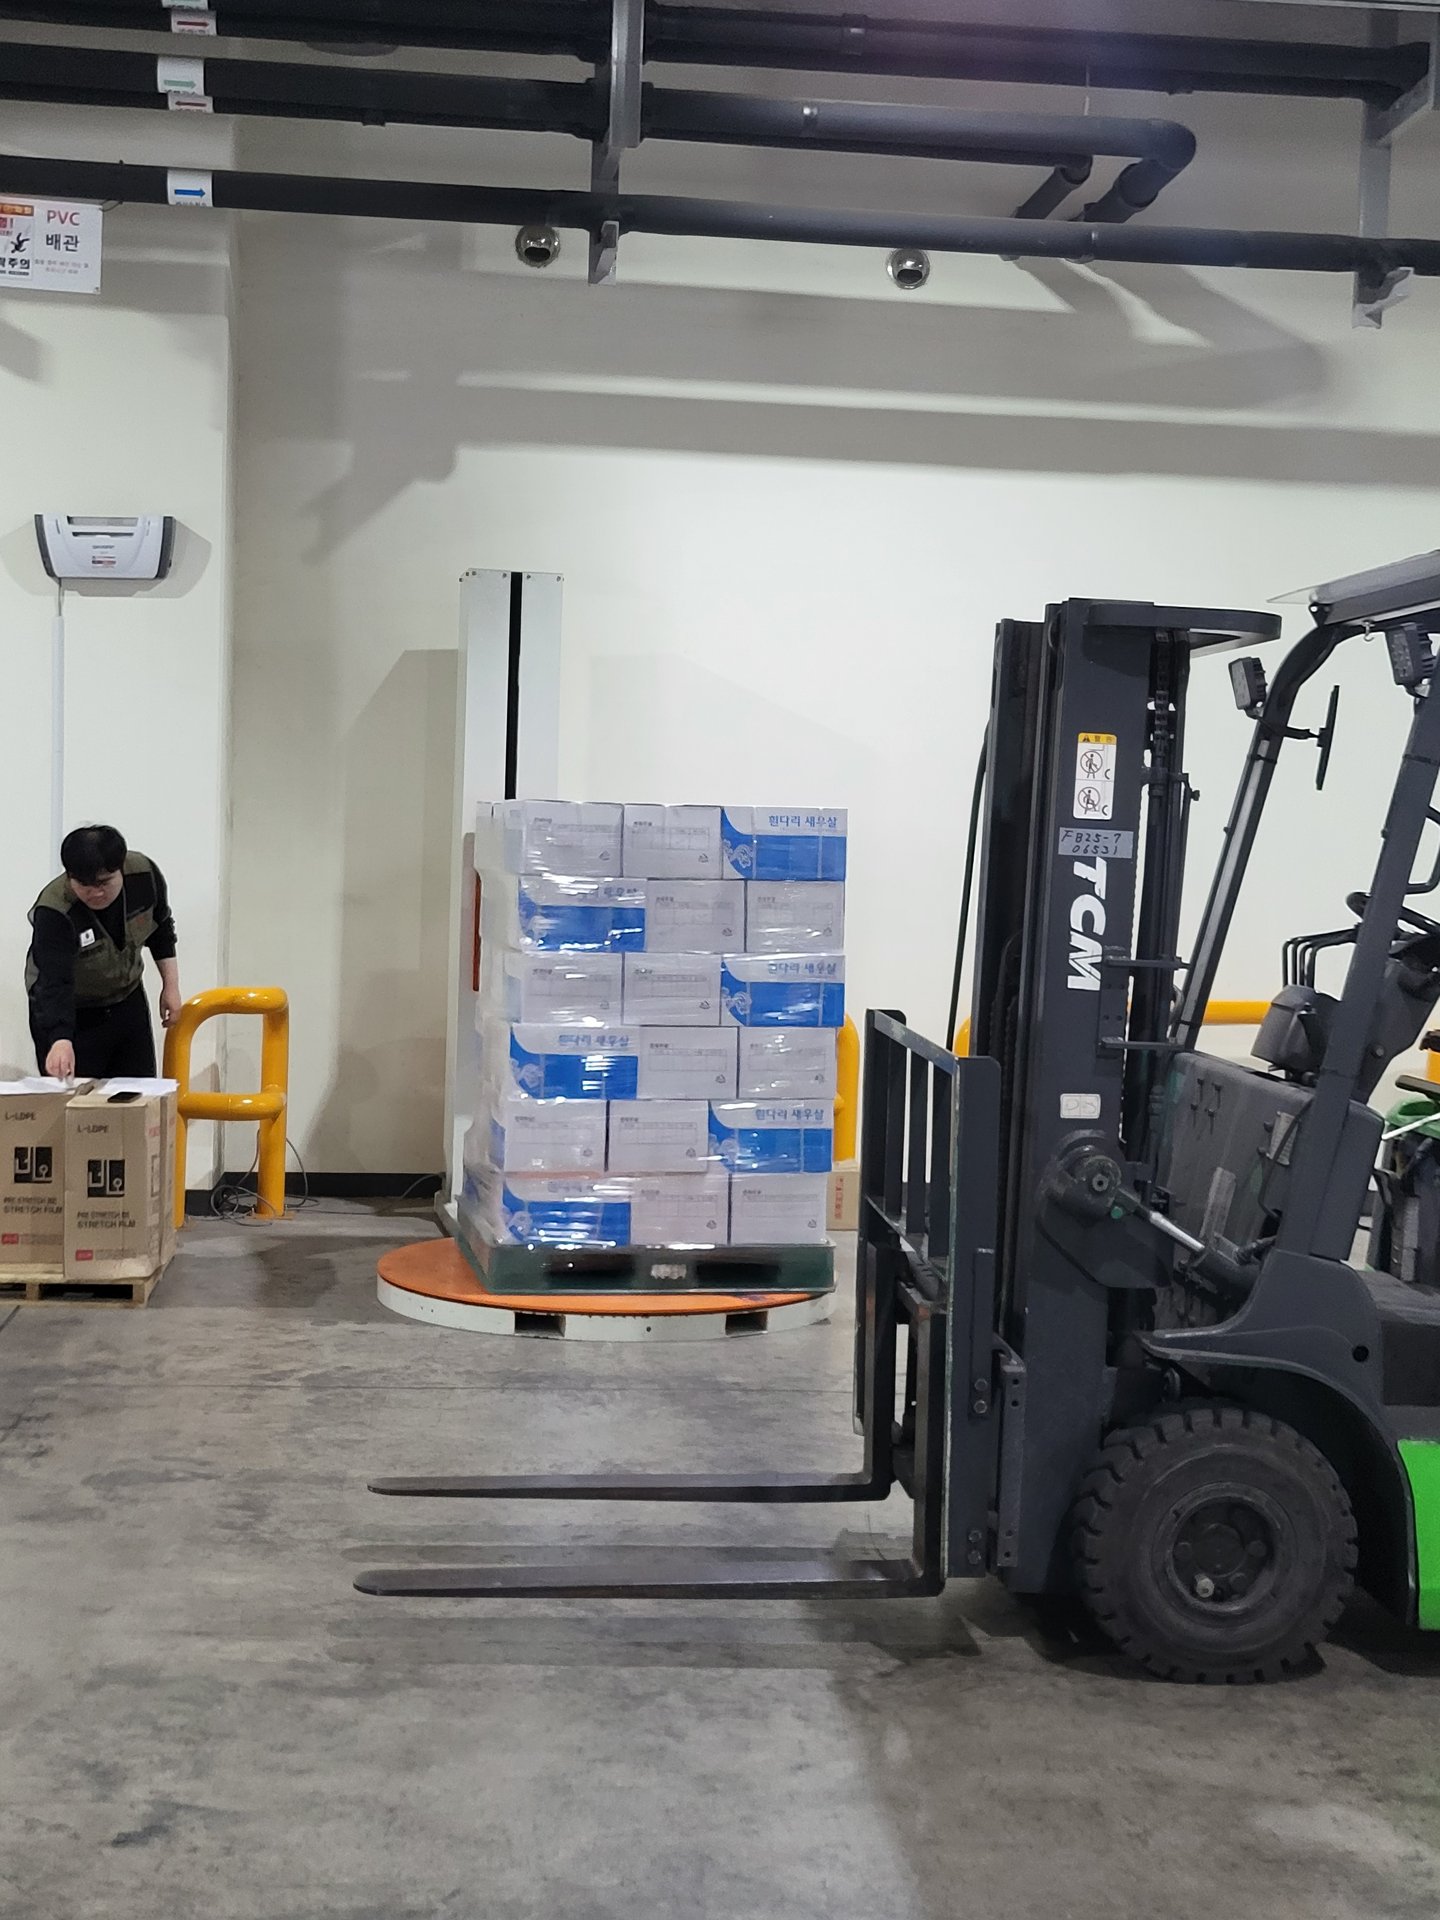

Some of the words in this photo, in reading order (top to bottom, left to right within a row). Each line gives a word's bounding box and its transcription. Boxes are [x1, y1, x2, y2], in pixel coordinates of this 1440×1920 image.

[47, 210, 80, 226] PVC
[46, 234, 80, 252] 배관
[769, 815, 801, 827] 흰다리
[805, 815, 837, 828] 새우살
[1061, 830, 1121, 843] FB25-7
[1072, 844, 1118, 855] 06531
[1067, 856, 1107, 991] TCM
